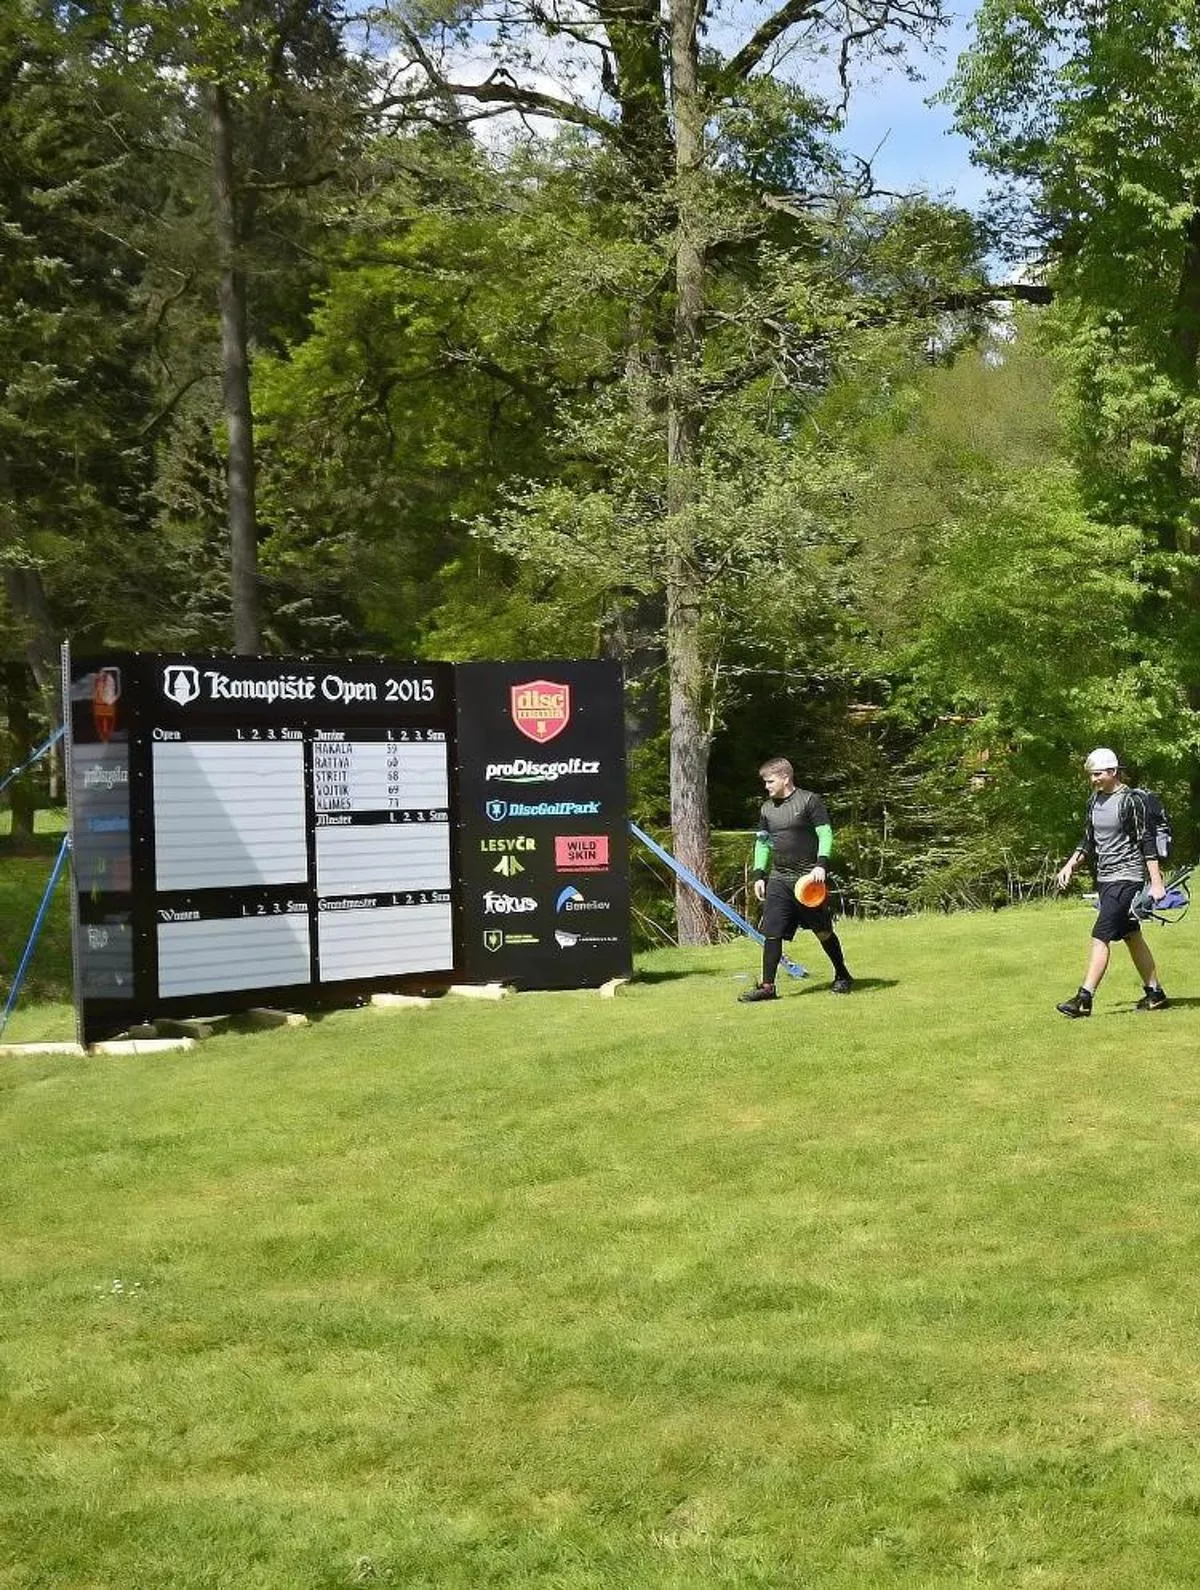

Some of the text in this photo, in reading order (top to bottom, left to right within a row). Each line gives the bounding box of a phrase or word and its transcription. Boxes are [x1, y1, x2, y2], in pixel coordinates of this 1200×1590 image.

[321, 674, 377, 704] Open
[384, 679, 434, 701] 2015
[518, 690, 565, 709] disc
[152, 727, 182, 740] Open
[280, 727, 304, 740] Sum
[314, 743, 353, 754] HAKALA
[485, 758, 600, 781] proDiscgolf.cz
[508, 801, 599, 816] DiscGolfPark
[567, 840, 596, 850] WILD
[567, 849, 597, 860] SKIN
